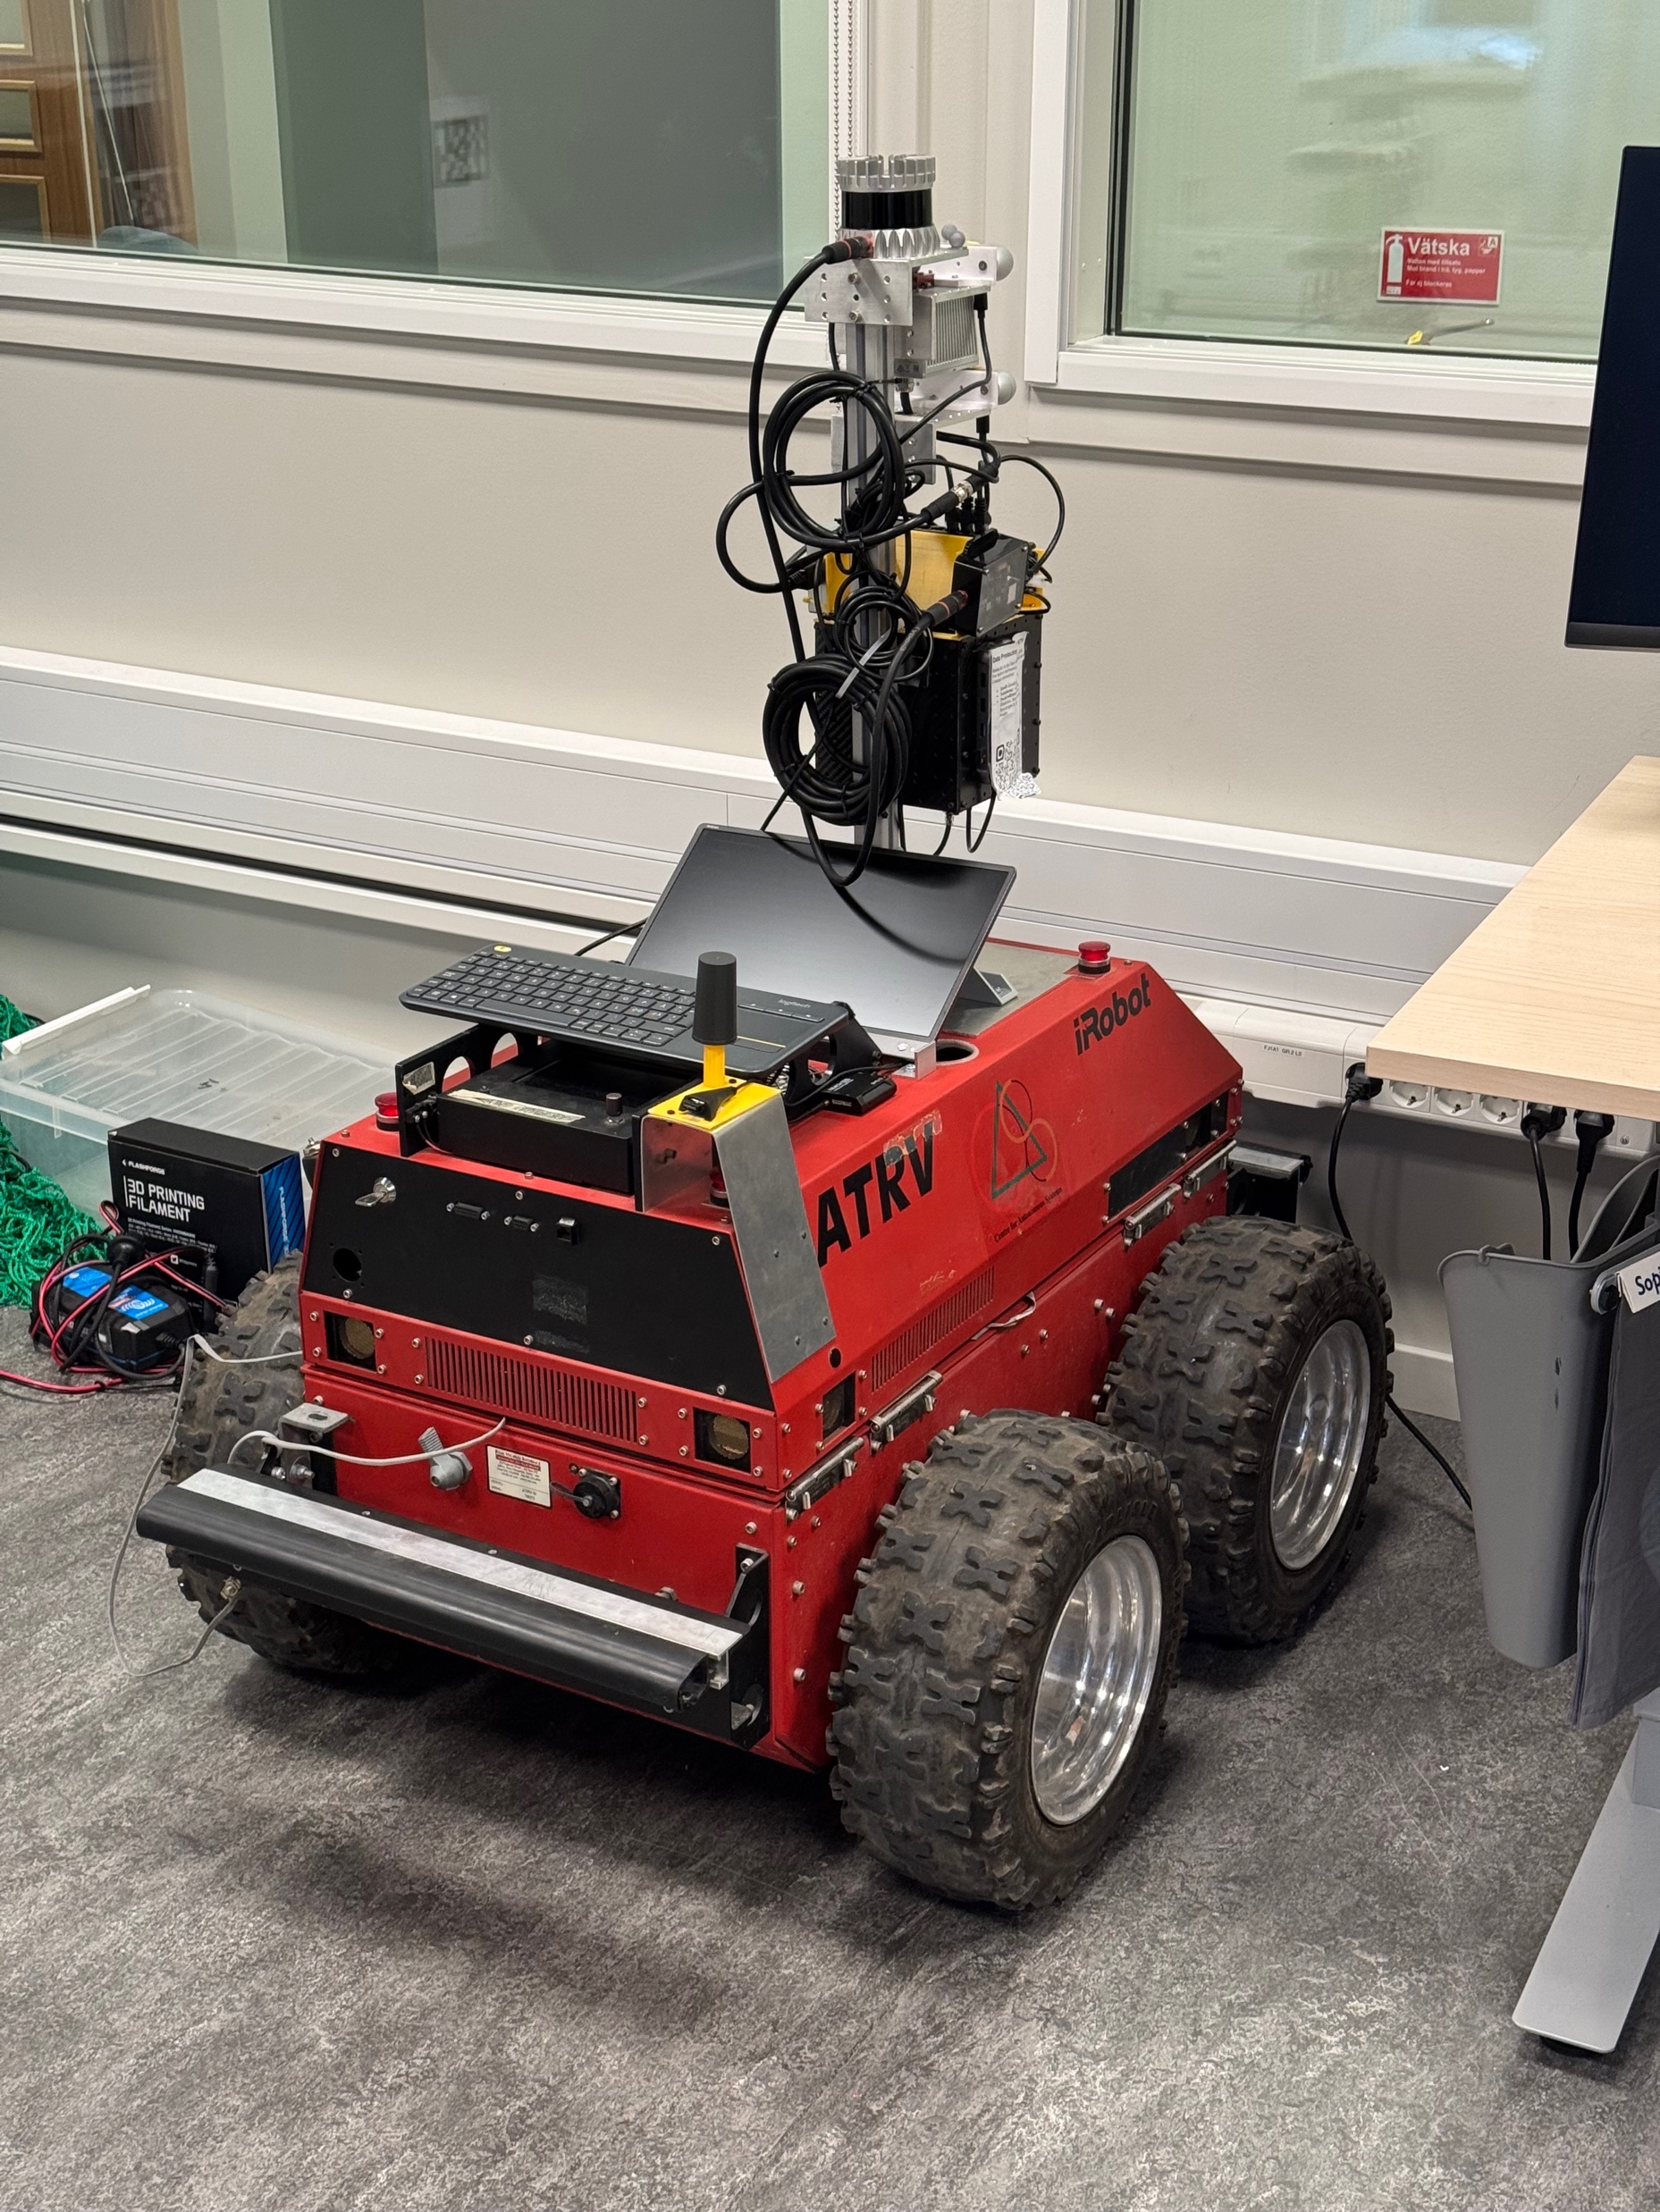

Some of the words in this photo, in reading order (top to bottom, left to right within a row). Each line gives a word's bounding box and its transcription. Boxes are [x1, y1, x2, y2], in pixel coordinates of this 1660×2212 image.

[1408, 237, 1470, 256] Vätska
[1074, 972, 1151, 1056] iRobot
[128, 1161, 165, 1175] FLASHFORGE
[127, 1178, 145, 1195] 3D
[147, 1183, 205, 1210] PRINTING
[129, 1194, 190, 1223] FILAMENT
[817, 1120, 933, 1268] ATRV
[1634, 1266, 1660, 1296] Sop
